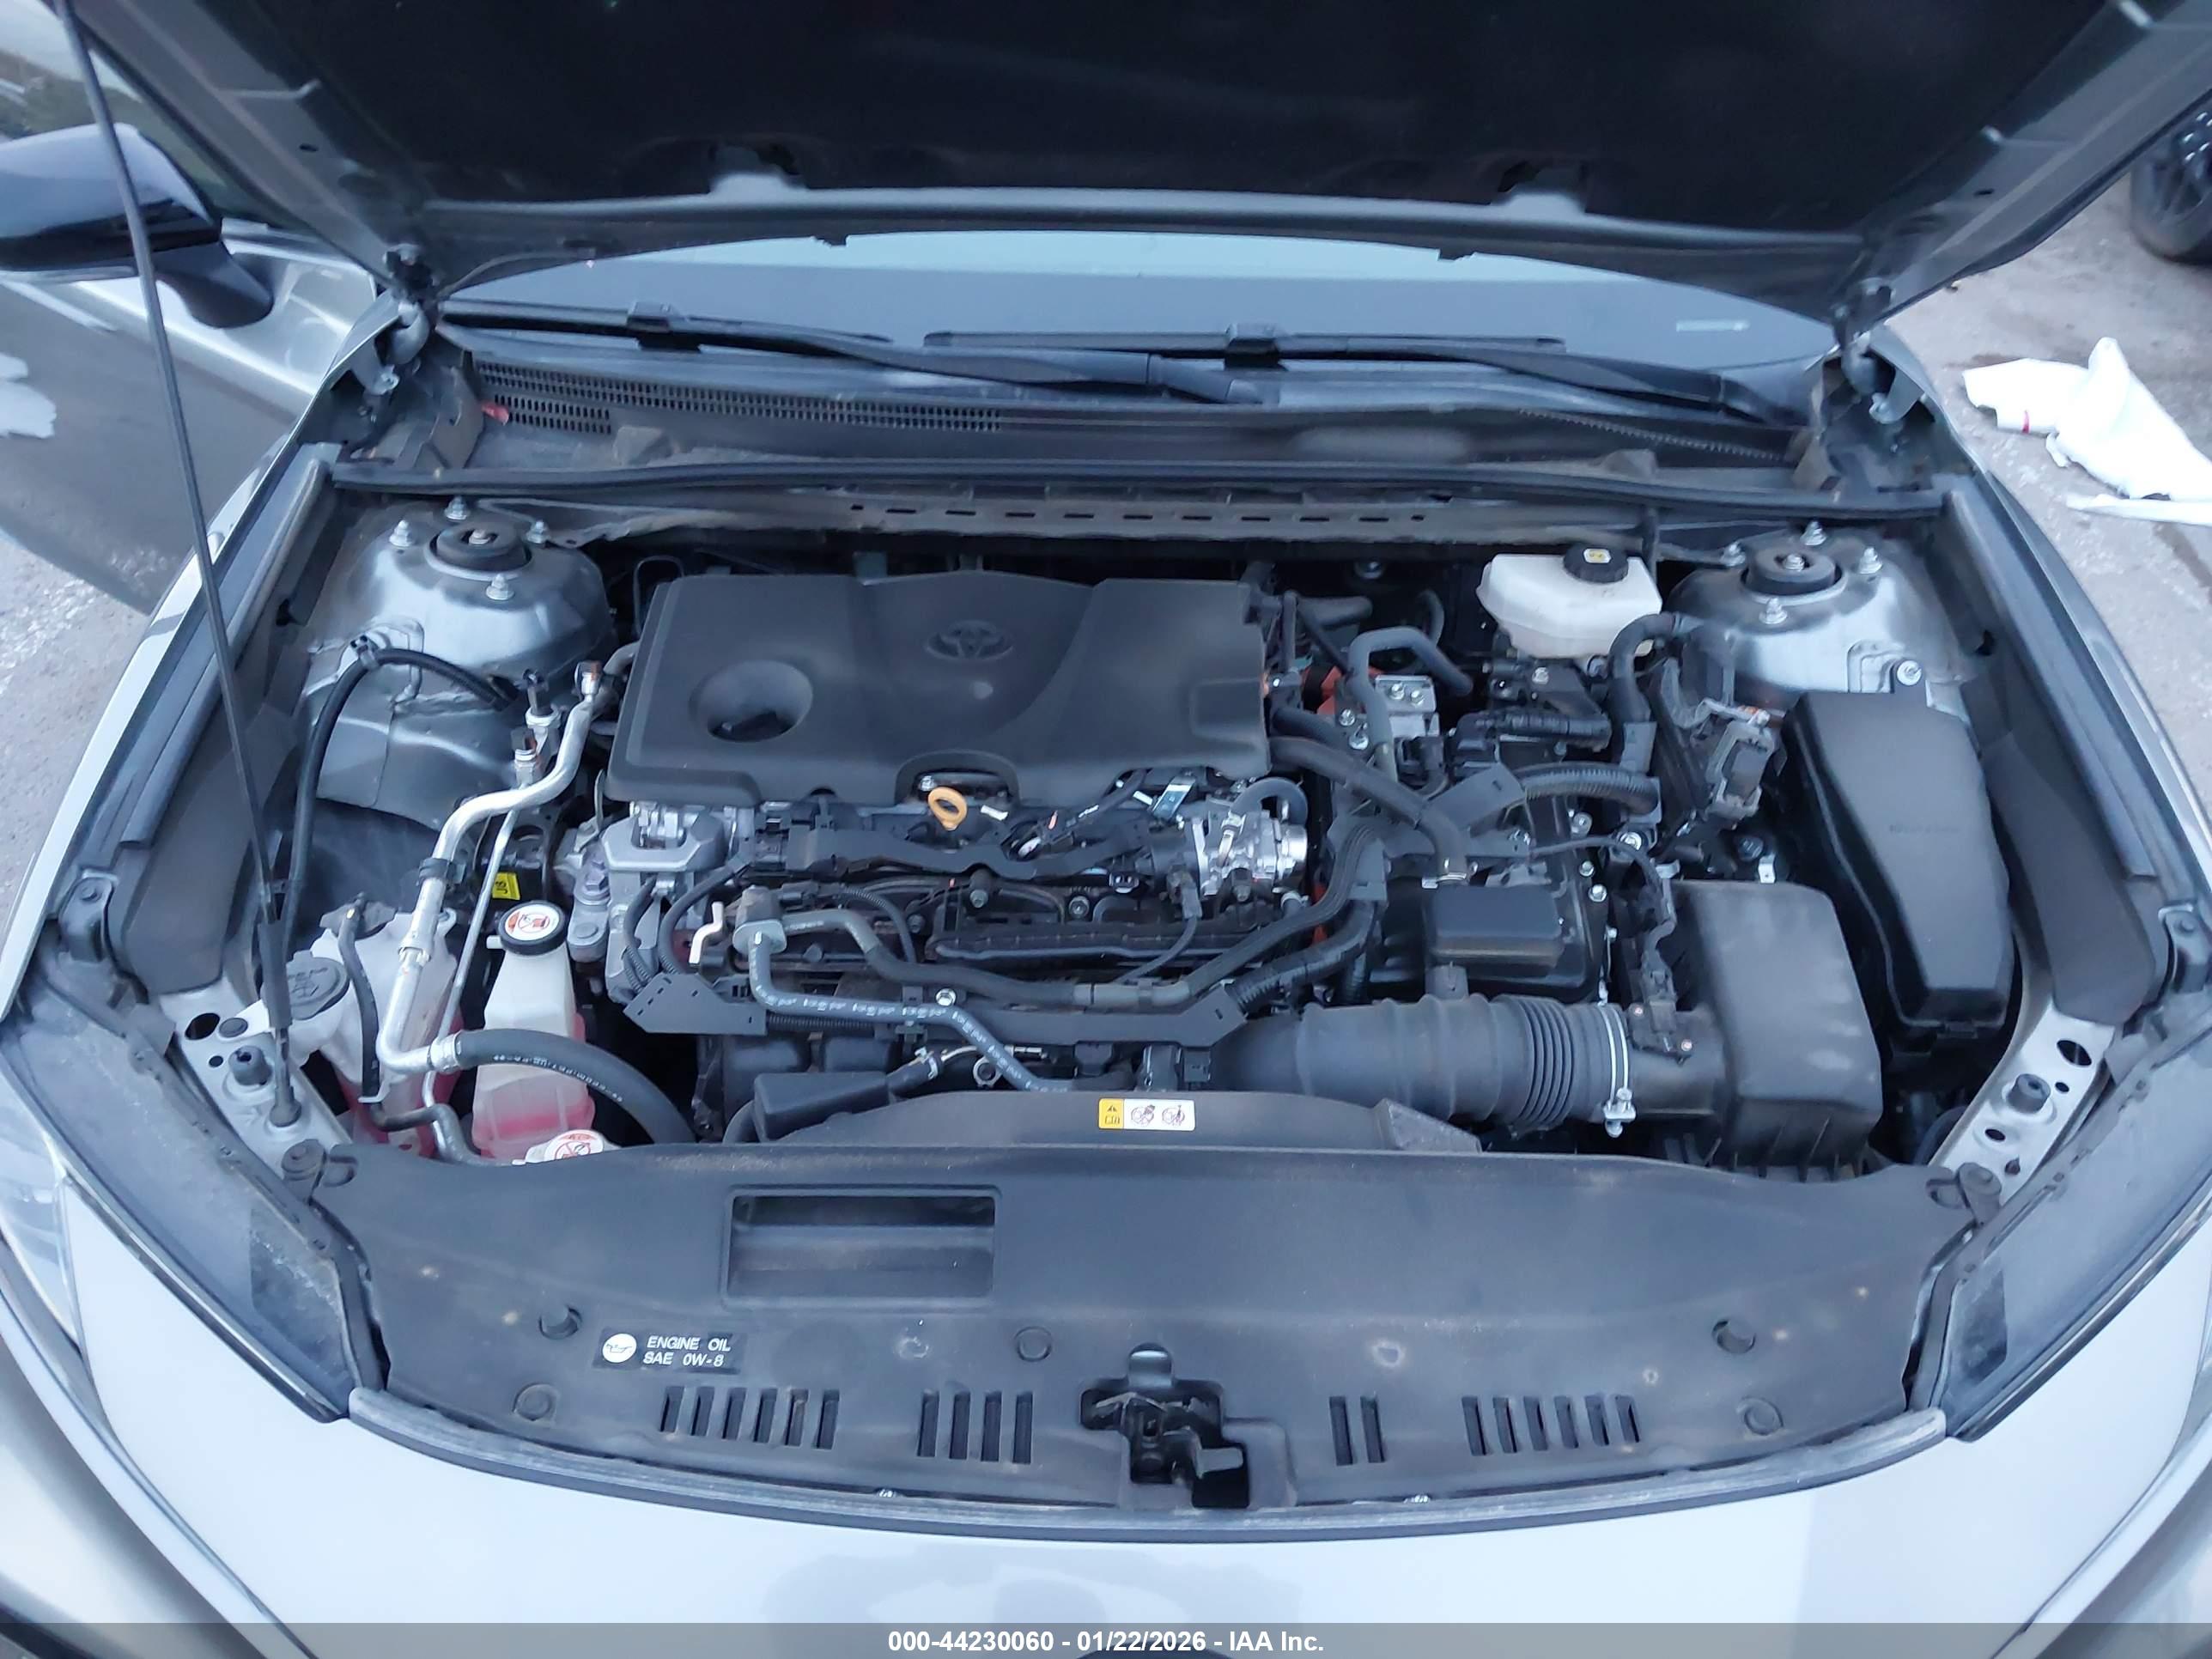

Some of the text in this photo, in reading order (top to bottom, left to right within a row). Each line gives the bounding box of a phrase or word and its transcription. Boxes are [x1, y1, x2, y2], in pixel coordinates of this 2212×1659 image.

[647, 1335, 732, 1352] ENGINE OIL
[642, 1351, 725, 1368] SAE 0W-8
